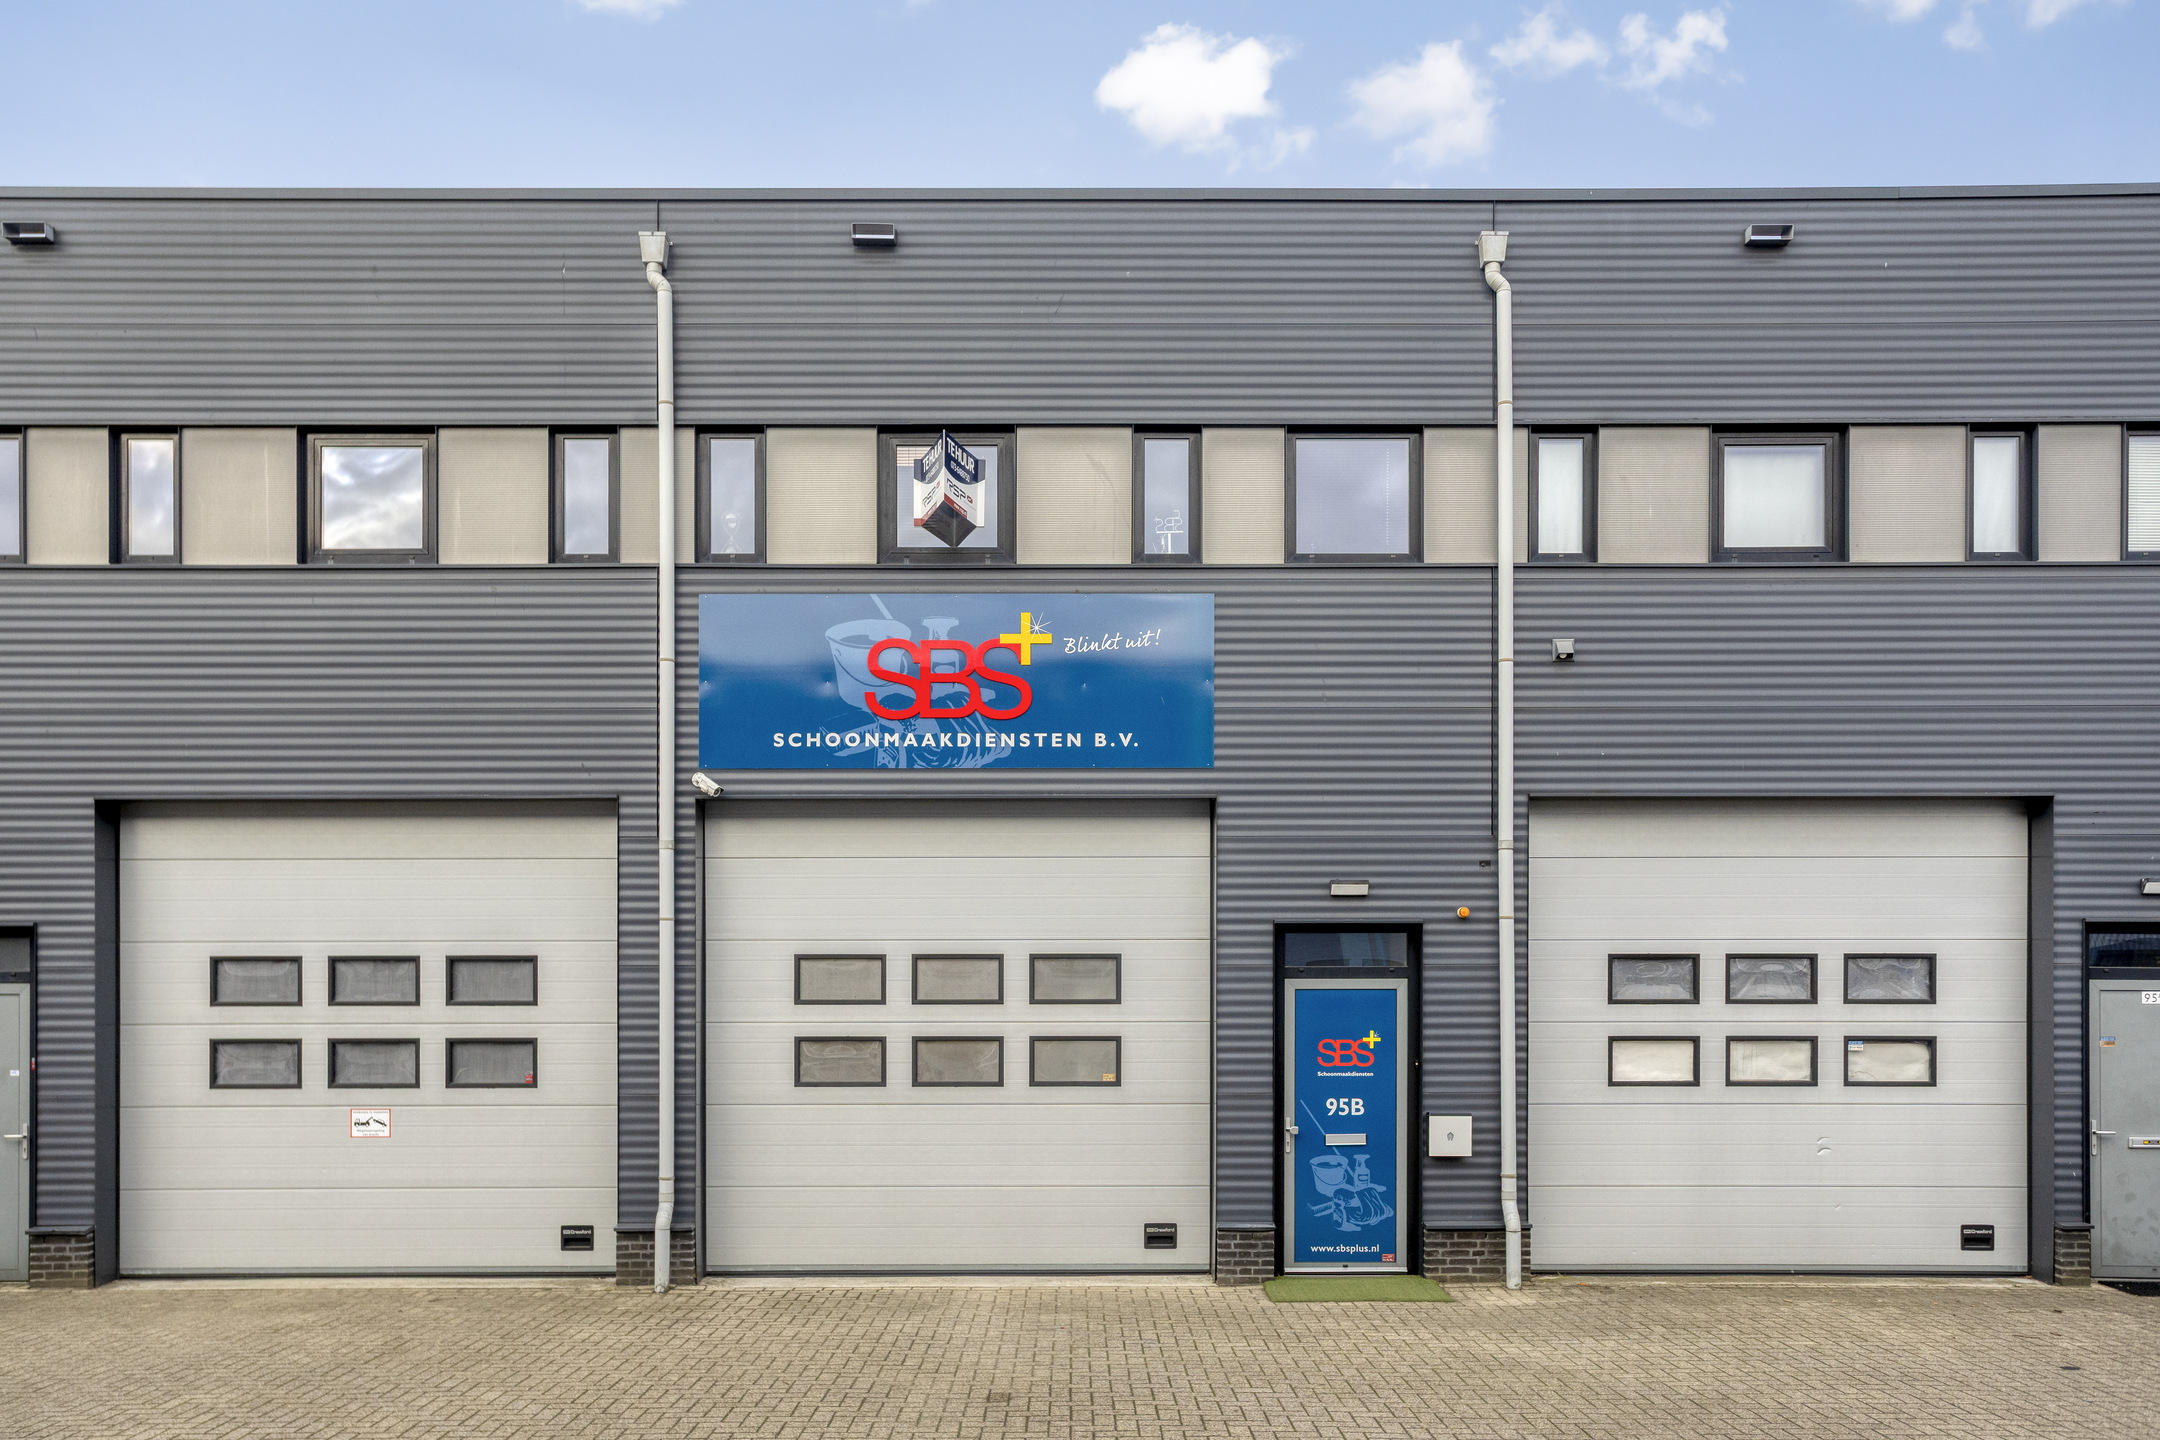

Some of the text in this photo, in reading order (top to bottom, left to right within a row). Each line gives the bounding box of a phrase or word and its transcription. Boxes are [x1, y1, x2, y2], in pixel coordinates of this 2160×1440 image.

[1063, 628, 1161, 654] Blinkt uit!
[773, 732, 1139, 747] SCHOONMAAKDIENSTEN B.V.
[2144, 992, 2160, 1003] 95
[1325, 1097, 1365, 1116] 95B
[1310, 1243, 1380, 1254] www.sbsplus.nl
